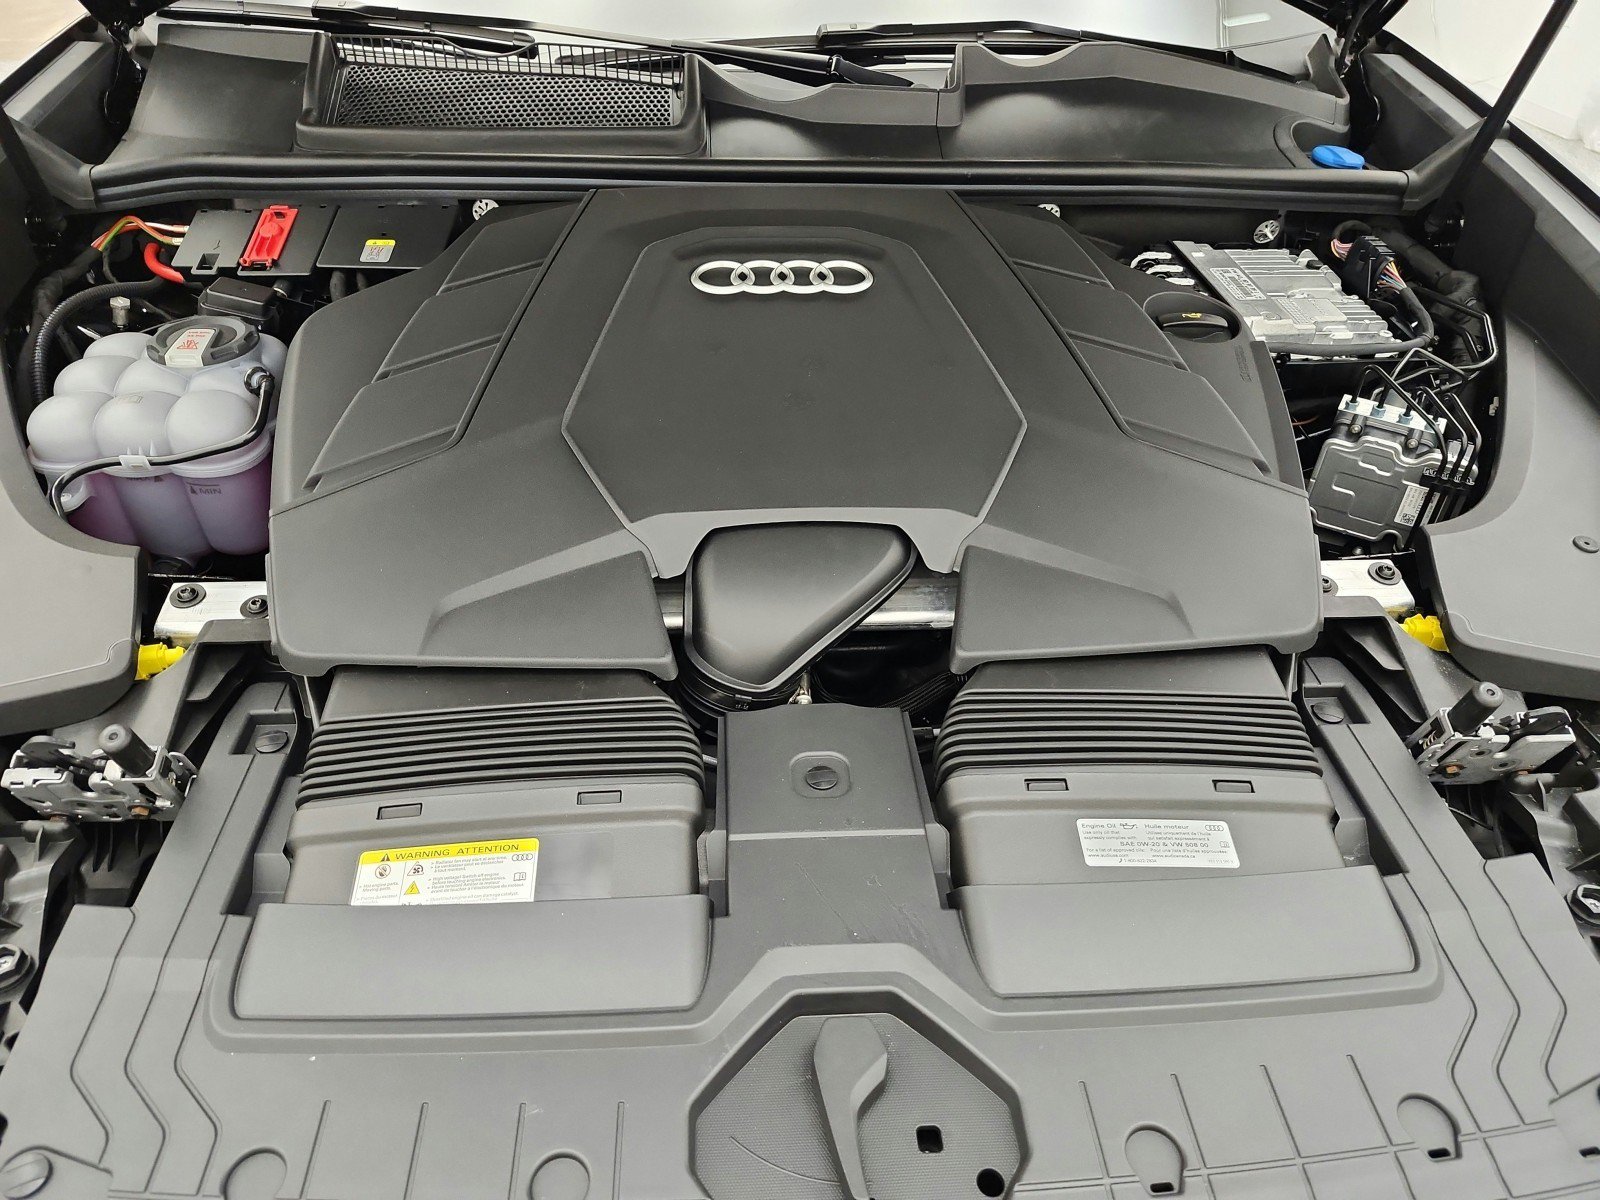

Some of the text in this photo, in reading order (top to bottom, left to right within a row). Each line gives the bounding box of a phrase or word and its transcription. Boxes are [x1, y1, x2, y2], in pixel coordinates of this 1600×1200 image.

[199, 487, 221, 495] MIN
[395, 844, 519, 860] WARNING ATTENTION
